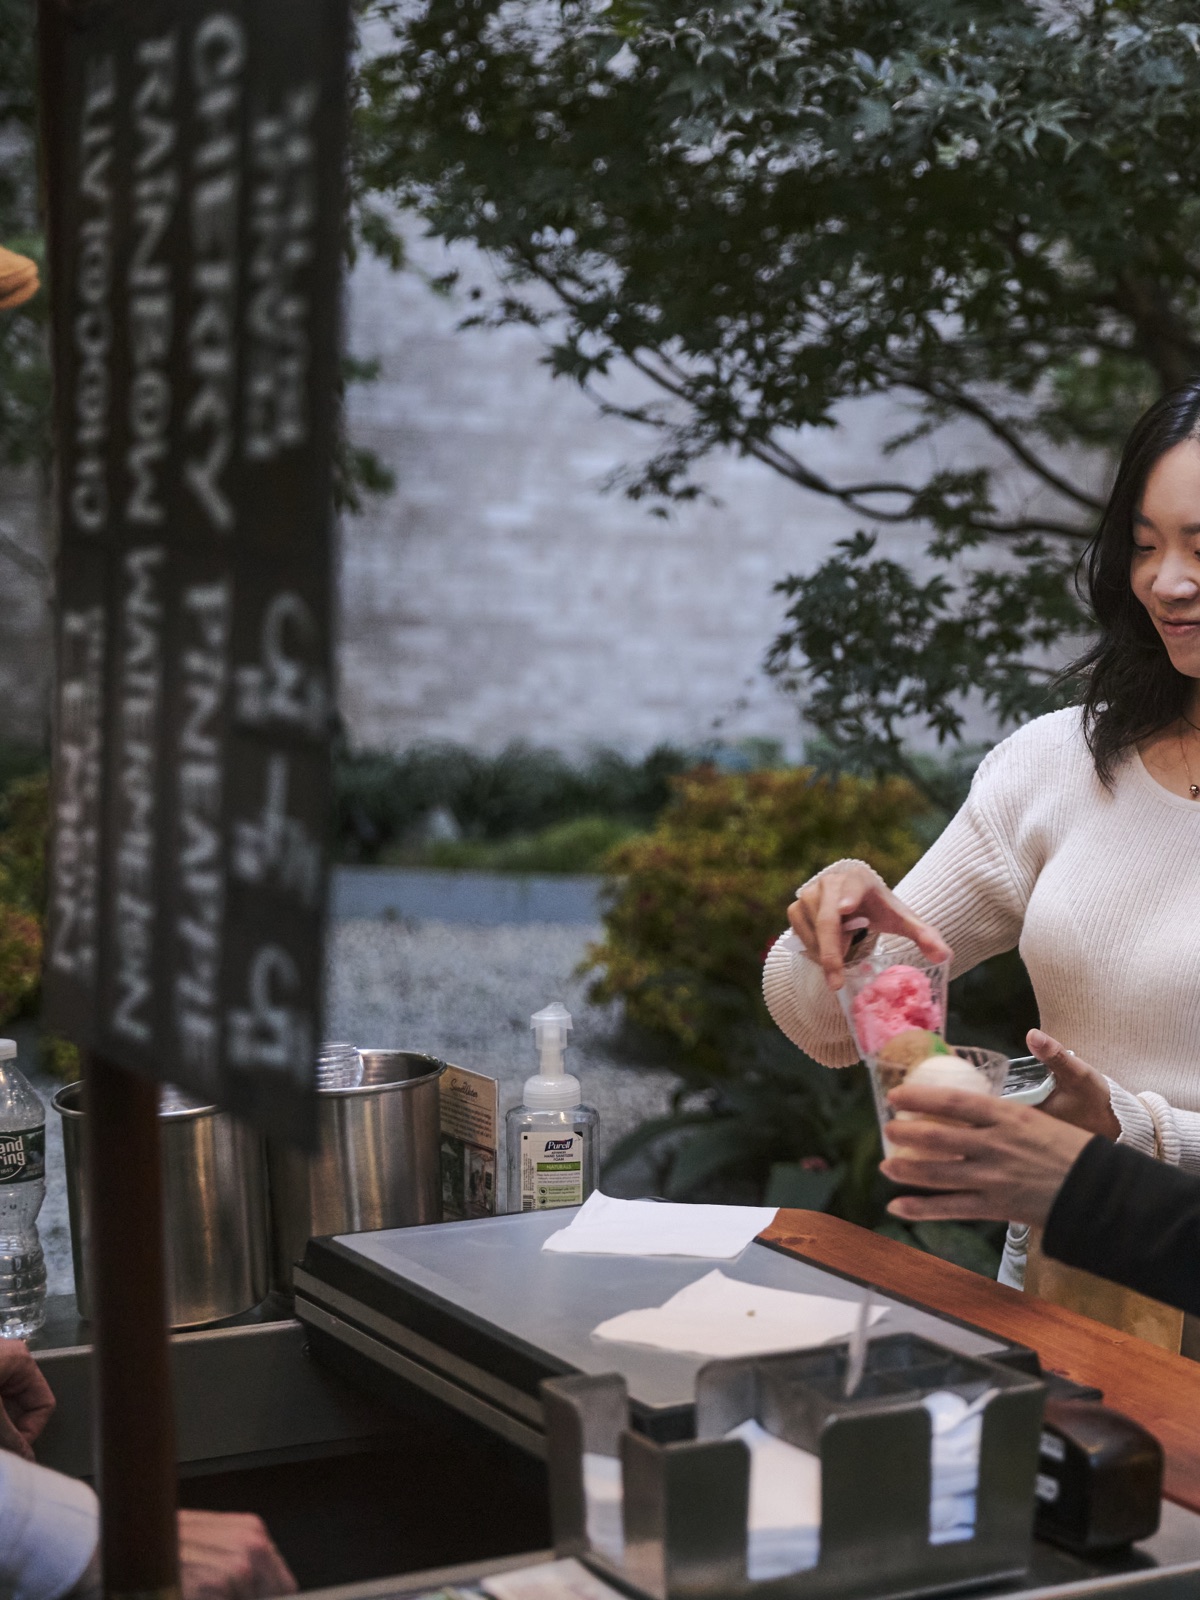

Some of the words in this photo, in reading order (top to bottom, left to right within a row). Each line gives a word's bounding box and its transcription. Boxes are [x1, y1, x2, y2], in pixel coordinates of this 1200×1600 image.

[72, 55, 117, 532] CHOCOLATE
[125, 33, 180, 524] RAINBOW
[184, 13, 247, 531] CHERRY
[113, 545, 168, 1042] WATERMELON
[176, 581, 229, 1082] PINEAPPLE
[548, 1140, 571, 1150] Purell
